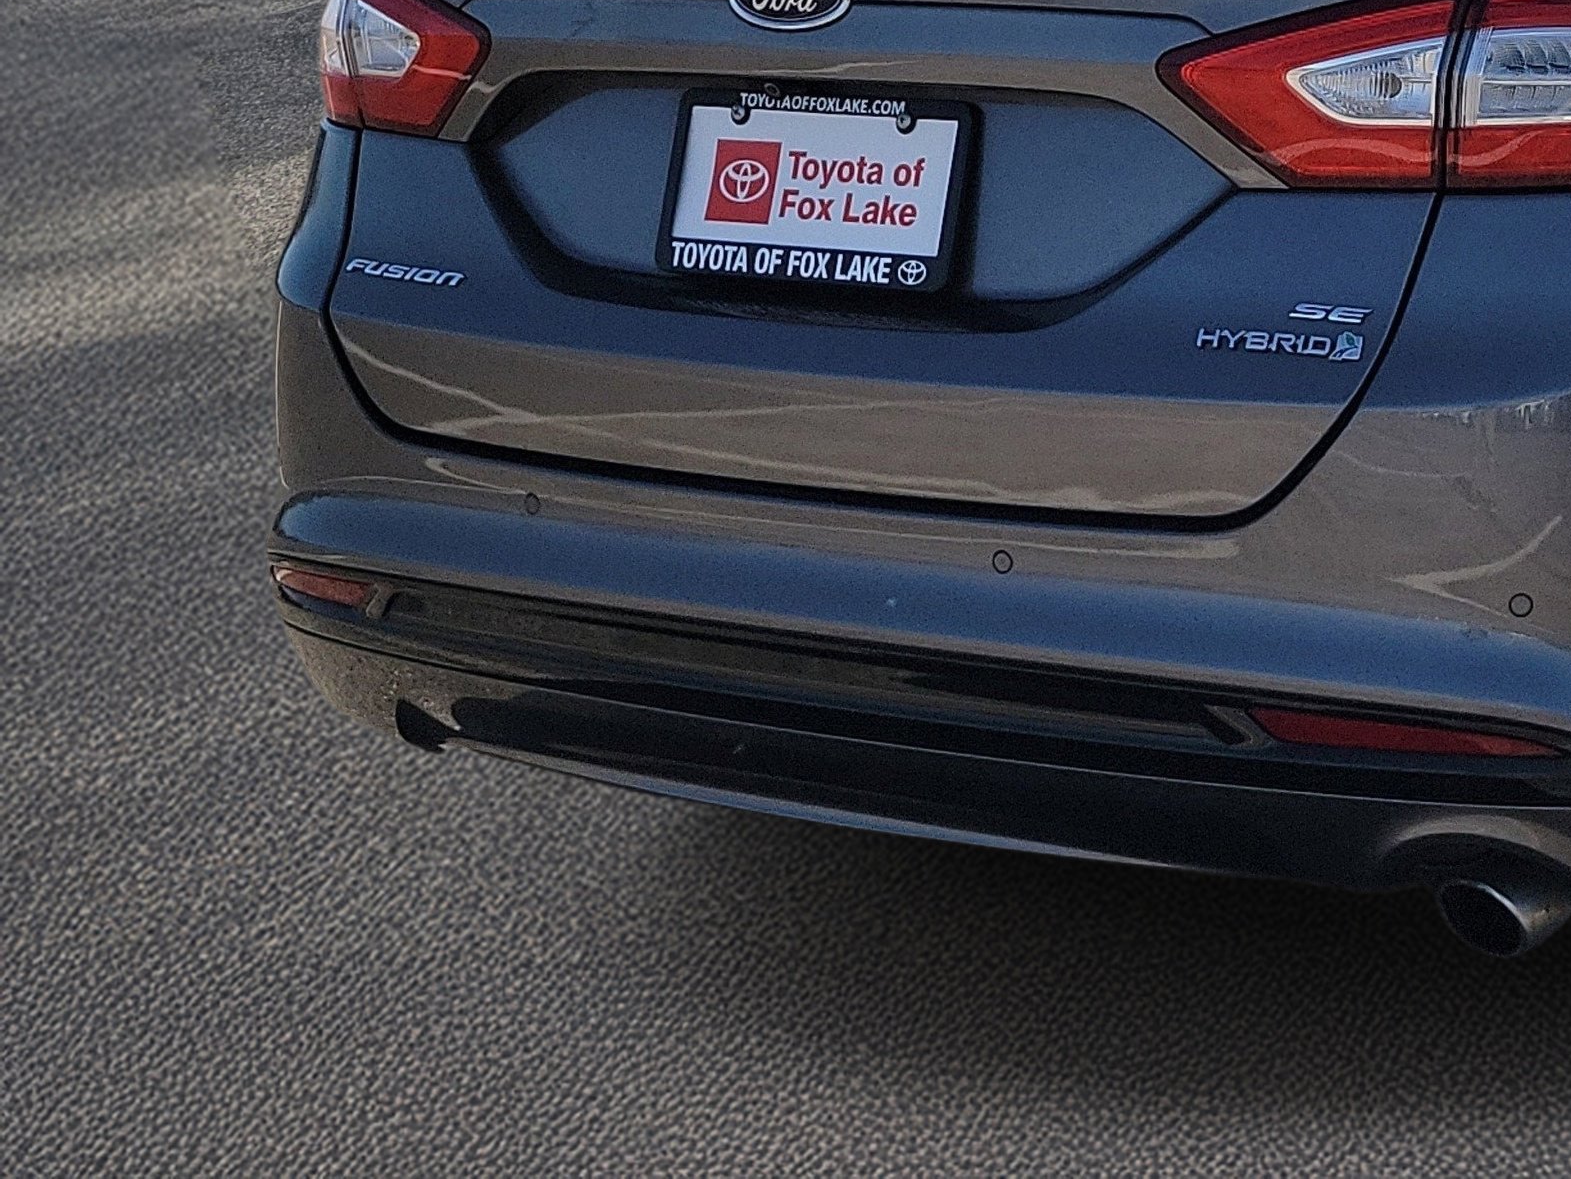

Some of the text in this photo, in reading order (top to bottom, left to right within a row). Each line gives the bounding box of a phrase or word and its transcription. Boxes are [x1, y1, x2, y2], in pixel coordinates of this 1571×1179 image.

[788, 150, 926, 189] Toyota of
[778, 189, 918, 226] Fox Lake
[346, 258, 466, 286] FUSION
[672, 241, 892, 285] TOYOTA OF FOX LAKE
[1289, 302, 1373, 323] SE
[1196, 328, 1331, 356] HYBRID
